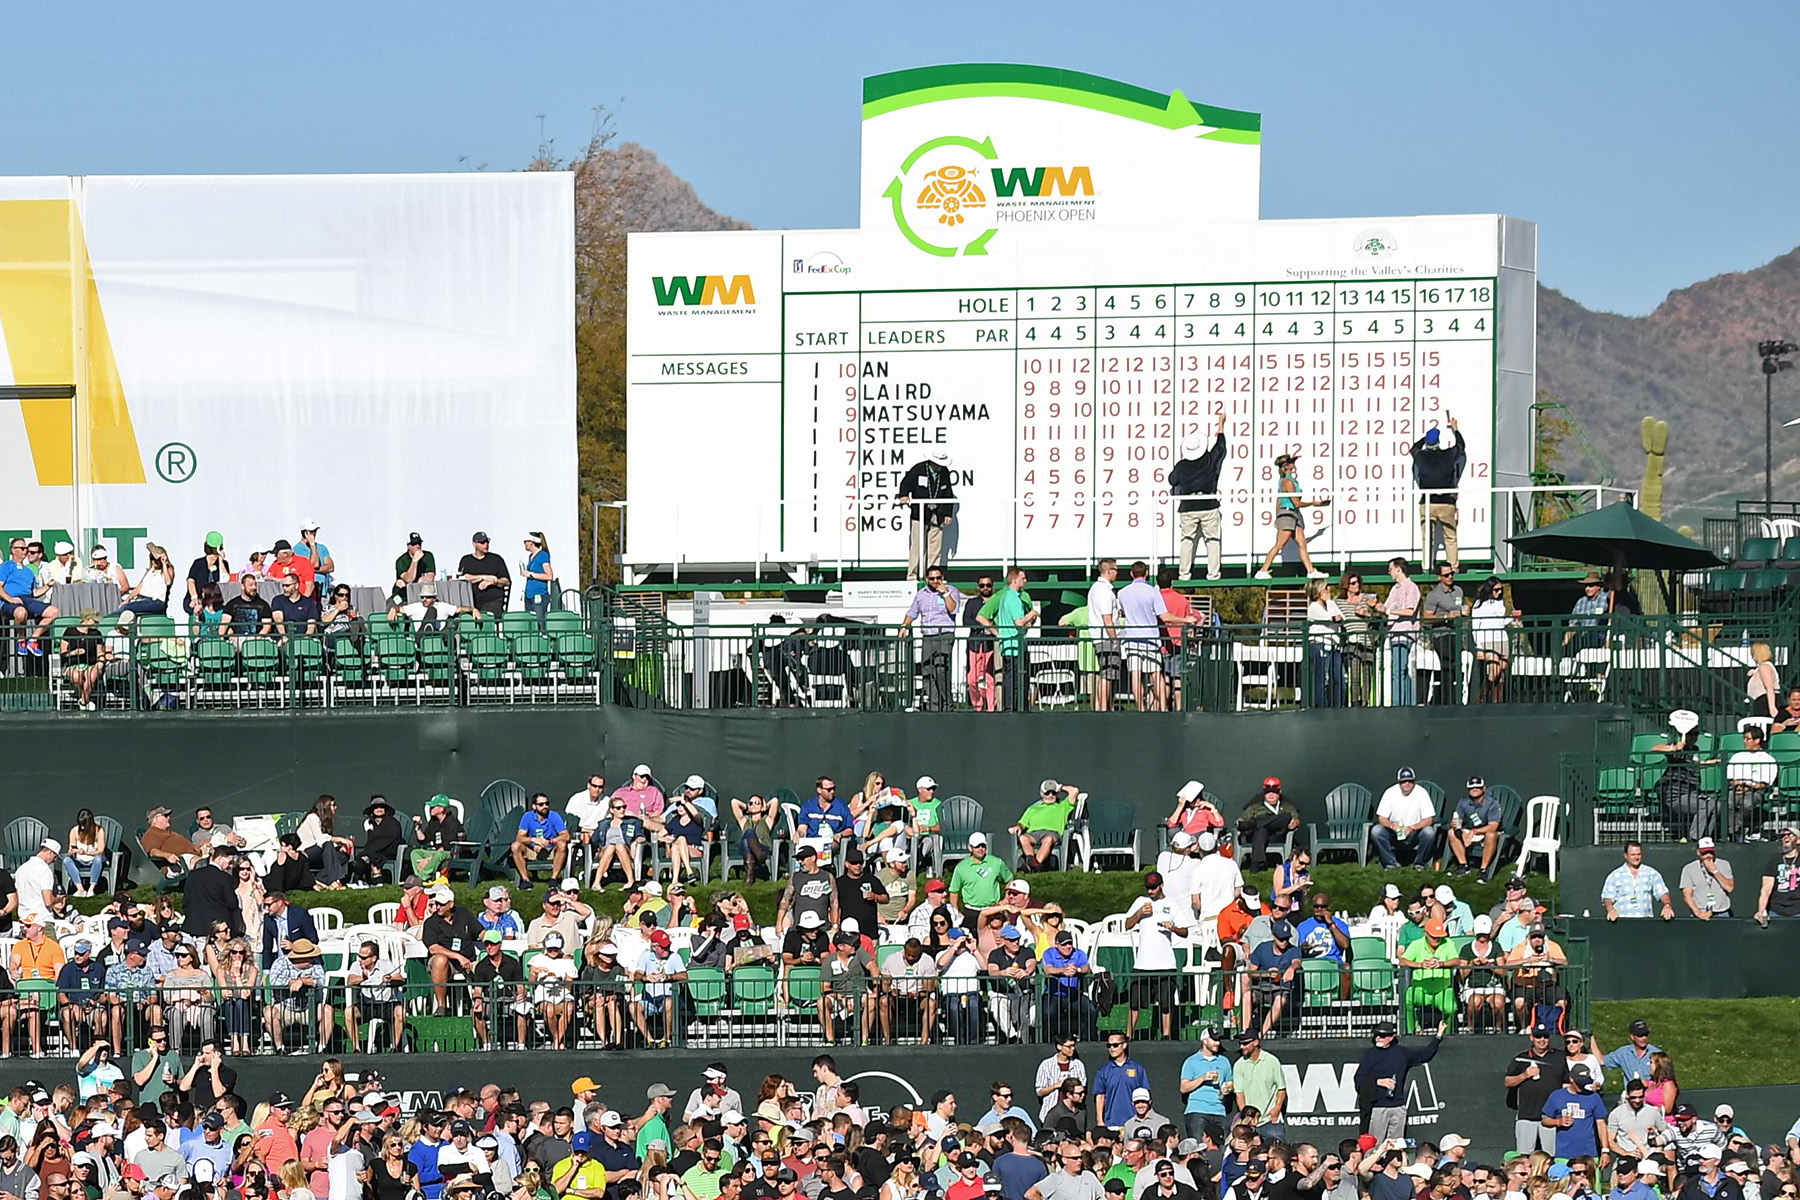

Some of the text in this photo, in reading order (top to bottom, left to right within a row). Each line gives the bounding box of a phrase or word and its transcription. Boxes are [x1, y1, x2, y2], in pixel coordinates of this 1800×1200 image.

[990, 166, 1095, 197] WM
[996, 208, 1096, 222] PHOENIX OPEN
[807, 264, 852, 275] FedExCup
[1285, 263, 1465, 280] Supporting the Valley's Charities
[651, 274, 756, 306] WM
[958, 287, 1490, 314] HOLE 1 2 3 4 5 6 7 8 9 10 11 12 13 14 15 16 17 18
[795, 331, 849, 347] START
[868, 317, 1486, 345] LEADERS PAR 4 4 5 3 4 4 3 4 4 4 4 3 5 4 5 3 4 4
[661, 361, 748, 376] MESSAGES
[839, 363, 857, 379] 10
[861, 360, 889, 379] AN
[1024, 358, 1042, 375] 10
[1049, 359, 1061, 373] 11
[1073, 358, 1090, 374] 12
[1101, 357, 1119, 373] 12
[1126, 356, 1144, 373] 12
[1152, 356, 1171, 372] 13
[1180, 355, 1198, 372] 13
[1207, 355, 1225, 369] 14
[1232, 355, 1251, 369] 14
[1259, 354, 1278, 370] 15
[1287, 353, 1305, 369] 15
[1313, 352, 1332, 369] 15
[1341, 352, 1360, 369] 15
[1367, 352, 1385, 368] 15
[1393, 351, 1412, 367] 15
[1422, 351, 1441, 367] 15
[845, 386, 857, 402] 9
[863, 382, 932, 401] LAIRD
[1023, 380, 1036, 397] 9
[1049, 380, 1061, 396] 8
[1074, 380, 1087, 396] 9
[1103, 379, 1121, 395] 10
[1128, 379, 1142, 393] 11
[1153, 378, 1171, 395] 12
[1181, 378, 1200, 394] 12
[1207, 377, 1225, 393] 12
[1233, 376, 1251, 393] 12
[1261, 376, 1279, 392] 12
[1287, 375, 1305, 392] 12
[1313, 375, 1331, 391] 12
[1341, 375, 1360, 391] 13
[1367, 375, 1386, 389] 14
[1393, 374, 1411, 389] 14
[1422, 373, 1441, 388] 14
[845, 407, 857, 423] 9
[862, 403, 991, 423] MATSUYAMA
[1024, 403, 1036, 419] 8
[1049, 402, 1061, 419] 9
[1074, 402, 1093, 418] 10
[1103, 401, 1121, 417] 10
[1128, 402, 1141, 417] 11
[1153, 400, 1171, 417] 12
[1181, 400, 1199, 416] 12
[1207, 399, 1224, 416] 12
[1233, 399, 1247, 414] 11
[1261, 399, 1274, 414] 11
[1285, 399, 1299, 413] 11
[1312, 399, 1325, 413] 11
[1341, 399, 1354, 413] 11
[1367, 398, 1380, 412] 11
[1393, 396, 1411, 412] 12
[1422, 396, 1440, 412] 13
[839, 427, 857, 443] 10
[864, 426, 948, 445] STEELE
[1023, 426, 1036, 441] 11
[1048, 425, 1061, 441] 11
[1074, 425, 1086, 439] 11
[1102, 424, 1115, 439] 11
[1127, 423, 1145, 439] 12
[1153, 423, 1171, 439] 12
[1232, 421, 1250, 437] 12
[1261, 421, 1279, 437] 12
[1287, 421, 1299, 436] 11
[1312, 421, 1325, 435] 11
[1341, 420, 1359, 436] 12
[1367, 419, 1385, 435] 12
[1392, 418, 1411, 435] 12
[847, 448, 905, 467] 7 KIM
[846, 469, 974, 489] 4 PETON
[845, 516, 857, 532] 6
[1286, 1116, 1335, 1126] WASTE
